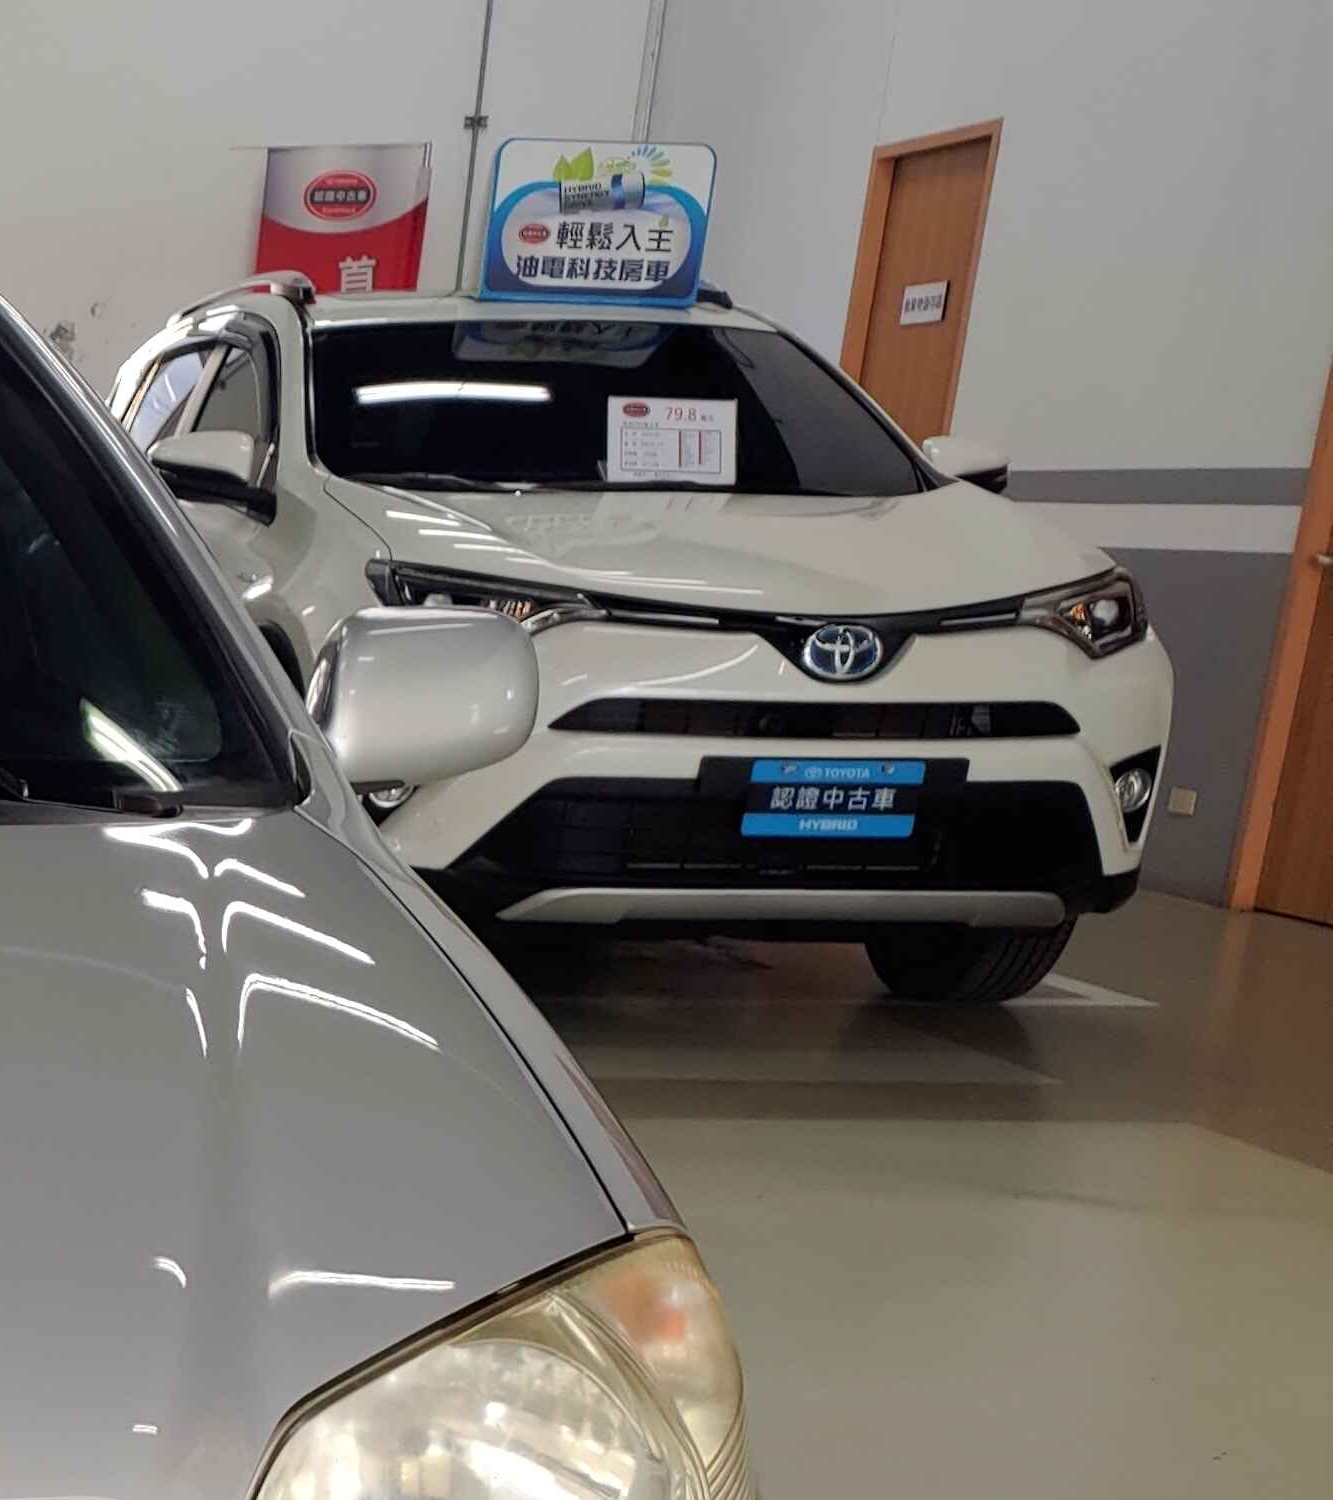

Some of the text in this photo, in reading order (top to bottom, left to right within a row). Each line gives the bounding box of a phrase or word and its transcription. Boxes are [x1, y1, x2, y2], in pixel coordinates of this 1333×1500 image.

[338, 255, 377, 293] 首
[516, 255, 671, 282] 油電科技房車
[665, 407, 697, 420] 79.8
[824, 767, 870, 779] TOYOTA
[770, 786, 896, 811] 認證中古車
[799, 818, 858, 831] HYBRID
